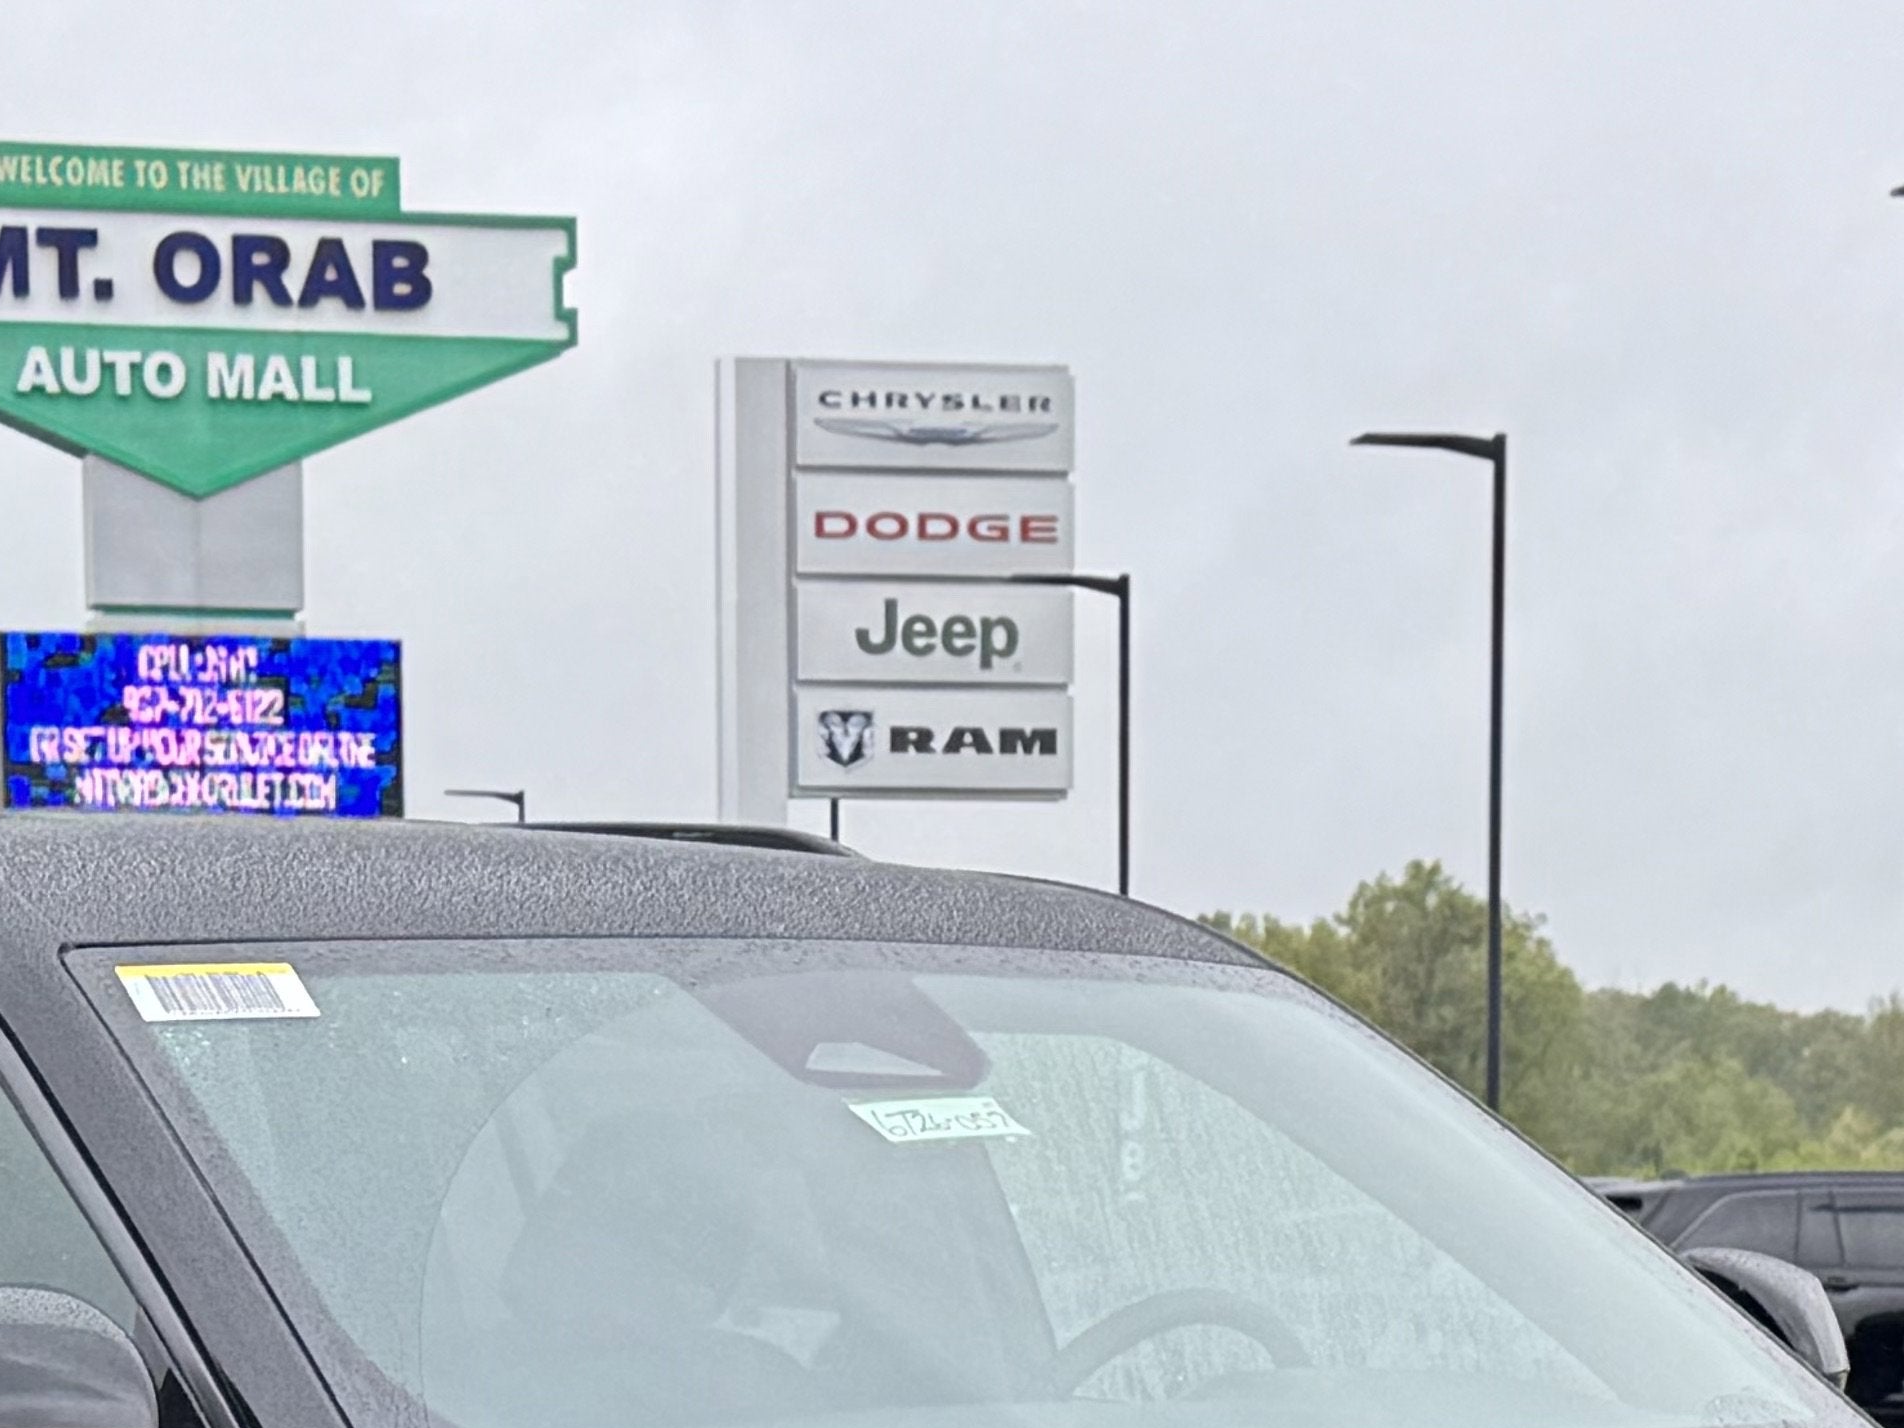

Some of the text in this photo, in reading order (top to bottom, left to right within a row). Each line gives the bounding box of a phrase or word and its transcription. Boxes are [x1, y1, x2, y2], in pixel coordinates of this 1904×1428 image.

[134, 159, 169, 190] TO
[177, 160, 227, 193] THE
[235, 163, 342, 197] VILLAGE
[350, 166, 385, 199] OF
[152, 230, 434, 312] ORAB
[16, 345, 373, 403] AUTO MALL
[818, 389, 1052, 414] CHRYSLER
[813, 510, 1060, 544] DODGE
[855, 597, 1020, 670] Jeep
[889, 725, 1058, 755] RAM
